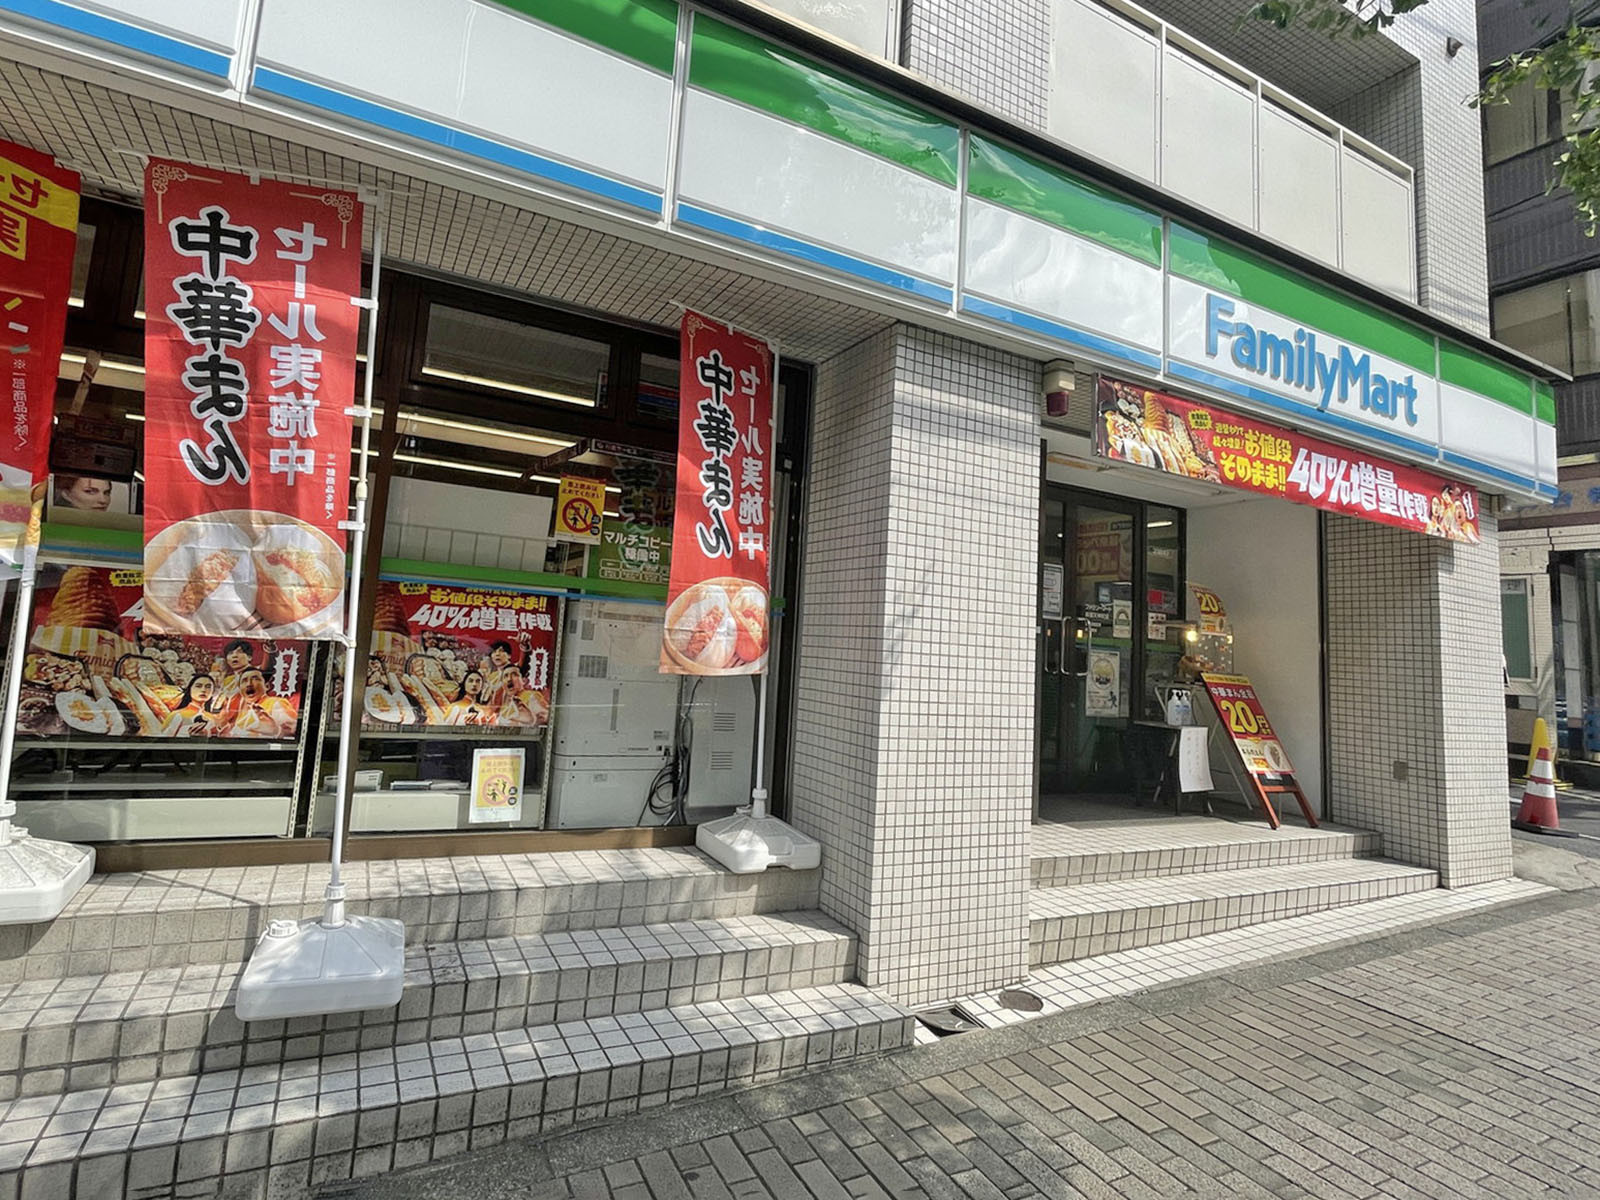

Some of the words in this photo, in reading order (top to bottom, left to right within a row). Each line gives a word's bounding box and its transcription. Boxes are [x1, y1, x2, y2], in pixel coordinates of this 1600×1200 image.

[1206, 293, 1418, 426] FamilyMart
[1244, 429, 1293, 464] お値段
[1287, 447, 1431, 524] 40%増量作戦
[603, 531, 671, 549] マルチコピー
[408, 604, 553, 631] 40%増量作戦
